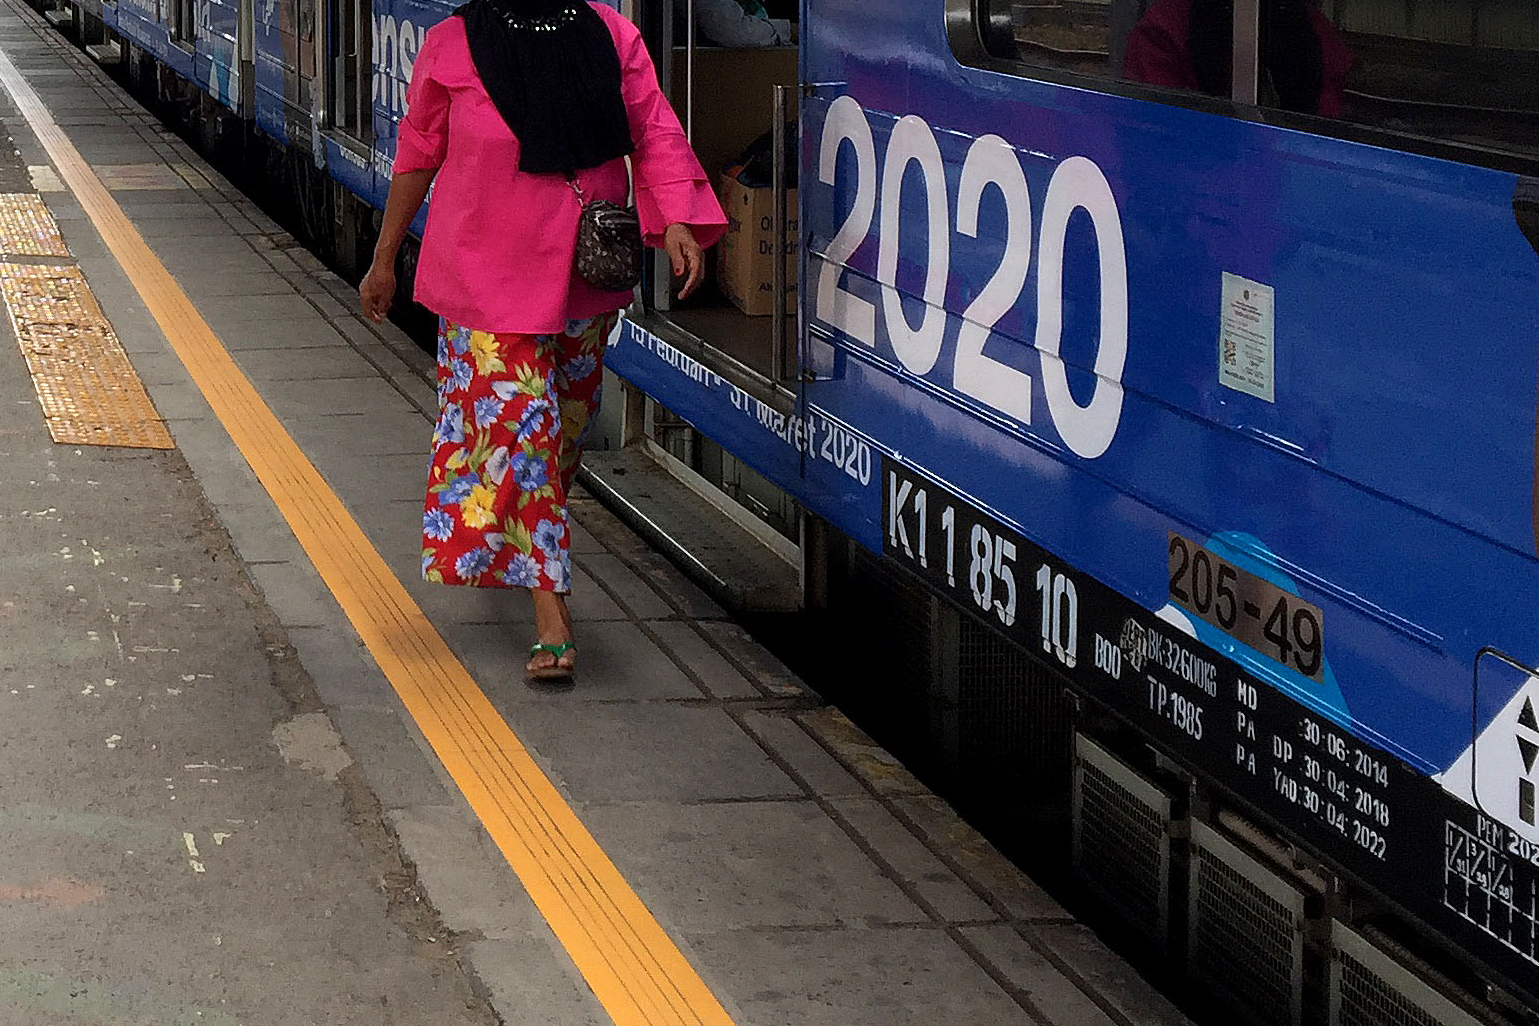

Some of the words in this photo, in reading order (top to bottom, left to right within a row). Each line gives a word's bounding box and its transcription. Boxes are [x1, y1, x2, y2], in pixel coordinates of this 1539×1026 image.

[815, 94, 1129, 459] 2020
[757, 402, 816, 459] Maret
[821, 419, 871, 487] 2020
[889, 470, 927, 568] K1
[942, 505, 956, 588] 1
[970, 524, 1017, 626] 85
[1036, 563, 1078, 669] 10
[1169, 536, 1322, 676] 205-49
[1273, 734, 1293, 763] DP
